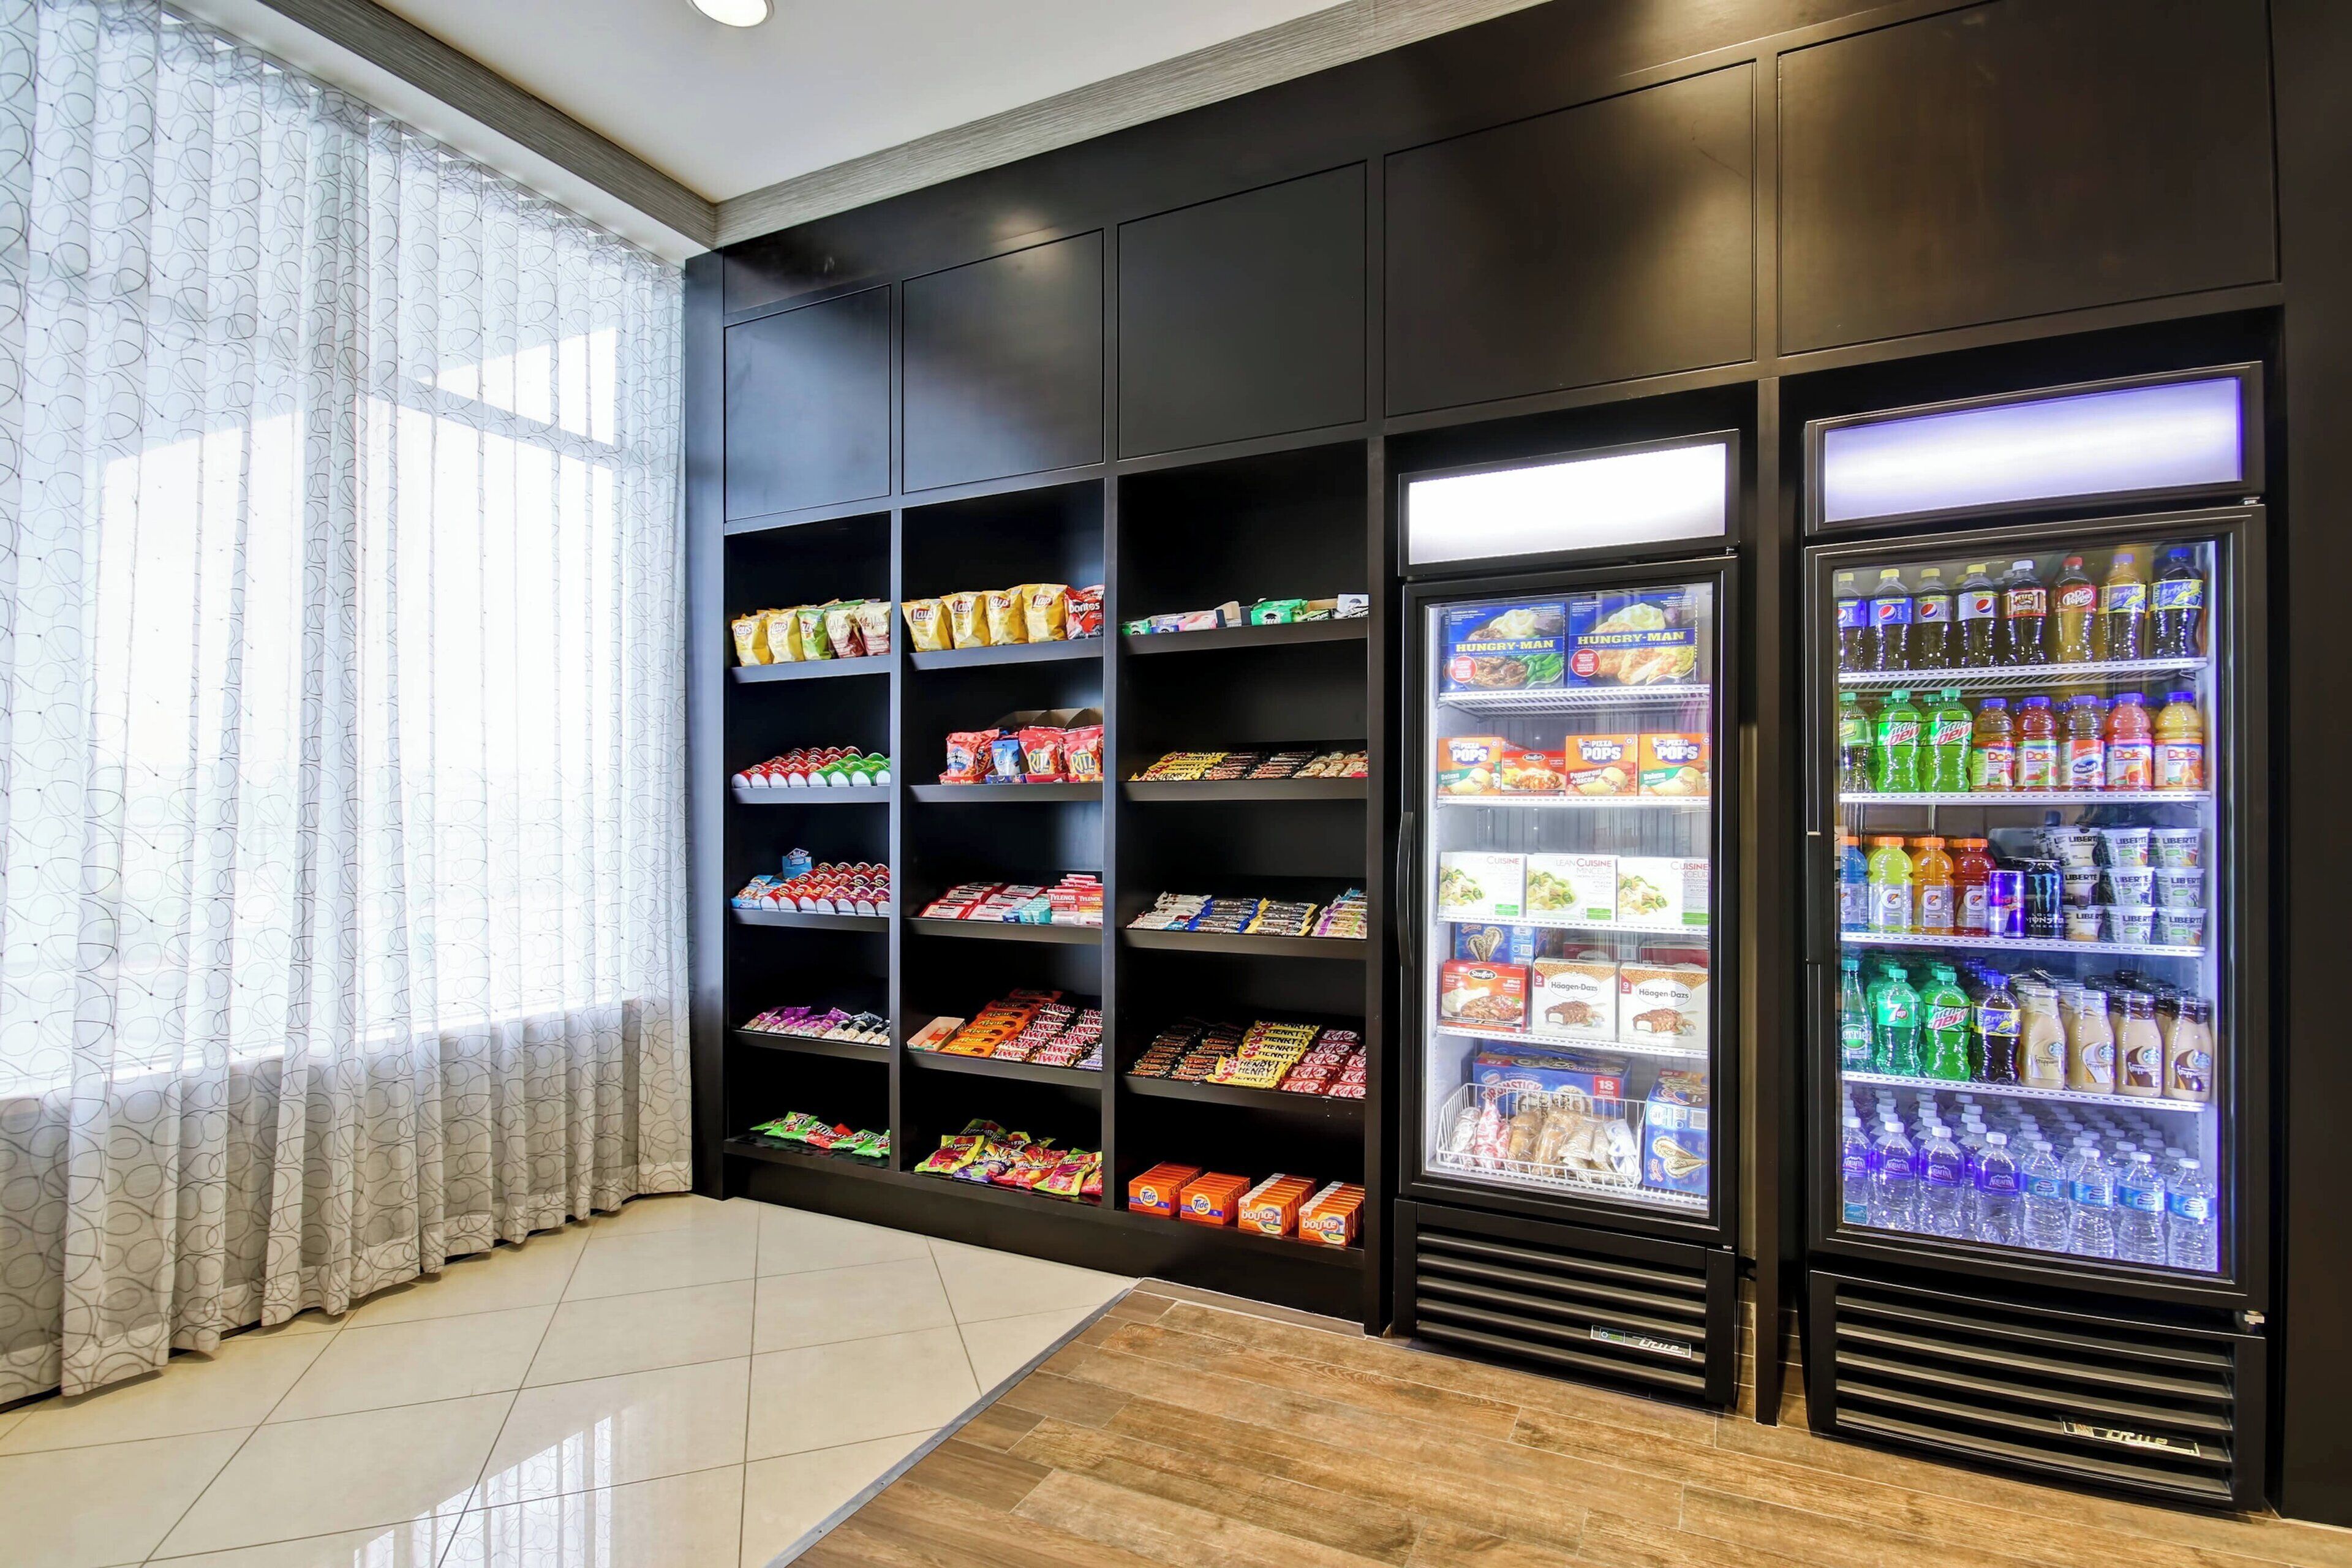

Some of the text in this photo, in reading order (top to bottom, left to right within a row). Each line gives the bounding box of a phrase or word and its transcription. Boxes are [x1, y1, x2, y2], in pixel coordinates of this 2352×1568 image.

[2065, 593, 2091, 605] Pepper
[1578, 631, 1685, 644] HUNGRY-MAN
[1456, 639, 1555, 652] HUNGRY-MAN
[1452, 748, 1487, 762] POPS
[1582, 747, 1621, 760] POPS
[1657, 747, 1698, 760] POPS
[1029, 753, 1050, 773] RITZ
[1072, 754, 1096, 774] RITZ
[1487, 856, 1520, 865] CUISINE
[1576, 858, 1612, 867] CUISINE
[1671, 862, 1708, 870] CUISINE
[1881, 889, 1902, 909] G
[1921, 890, 1942, 910] G
[1964, 890, 1985, 911] G
[1985, 1013, 2010, 1023] Brisk
[1033, 1022, 1063, 1031] TWIX
[1023, 1030, 1052, 1039] TWIX
[1842, 1030, 1866, 1041] errie
[996, 1050, 1027, 1058] TWIX
[1046, 1044, 1077, 1054] TWIX
[1036, 1054, 1069, 1063] TWIX
[1598, 1080, 1614, 1090] 18
[1142, 1191, 1156, 1201] Tide
[1194, 1199, 1209, 1209] Tide
[1242, 1209, 1275, 1221] bounce
[1303, 1219, 1337, 1231] bounce
